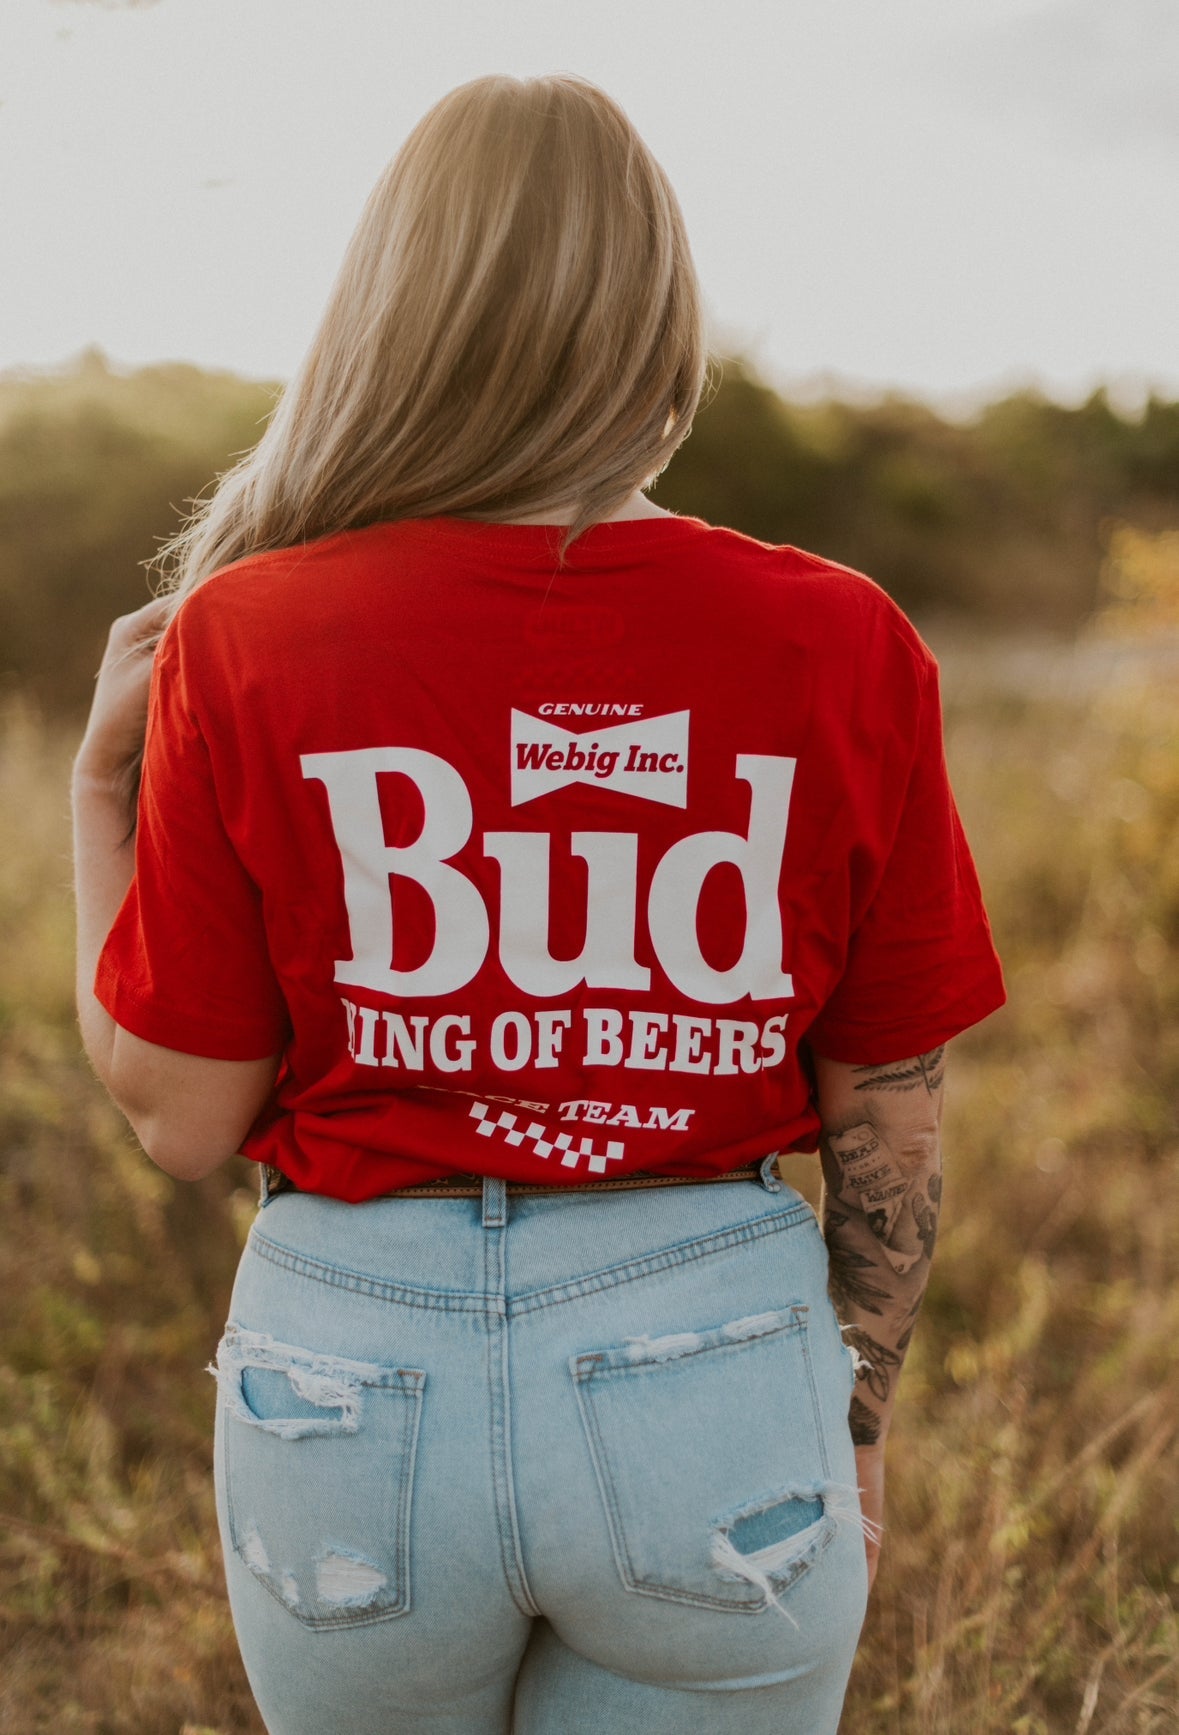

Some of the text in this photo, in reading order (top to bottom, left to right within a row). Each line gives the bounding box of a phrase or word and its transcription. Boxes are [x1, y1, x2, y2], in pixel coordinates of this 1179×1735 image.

[538, 702, 645, 716] GENUINE
[516, 742, 685, 778] Webig Inc.
[300, 746, 797, 1005] Bud
[490, 1010, 572, 1073] OF
[582, 1009, 789, 1076] BEERS
[417, 1084, 697, 1131] CE TEAM
